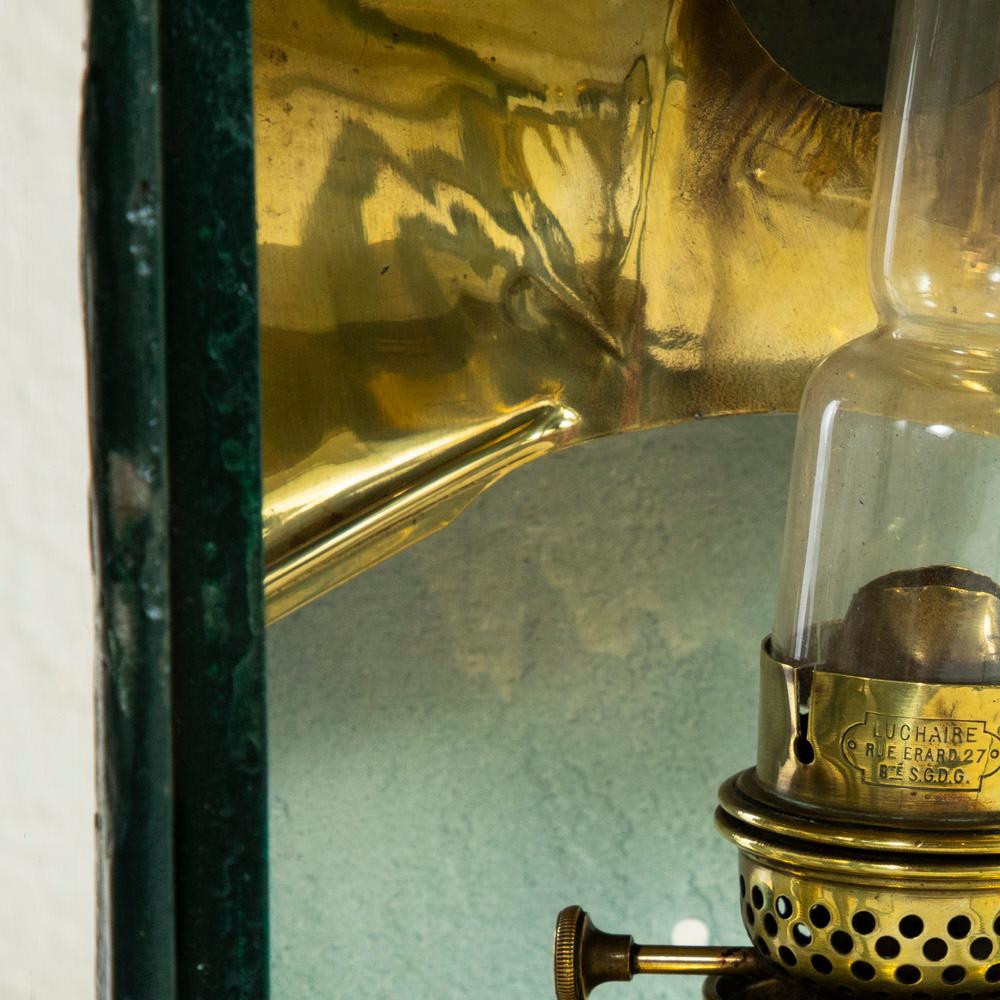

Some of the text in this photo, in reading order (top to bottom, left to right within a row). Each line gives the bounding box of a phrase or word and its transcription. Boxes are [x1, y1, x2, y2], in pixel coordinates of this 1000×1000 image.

[873, 719, 978, 743] LUCHAIRE
[865, 742, 987, 764] RUE ERARD 27
